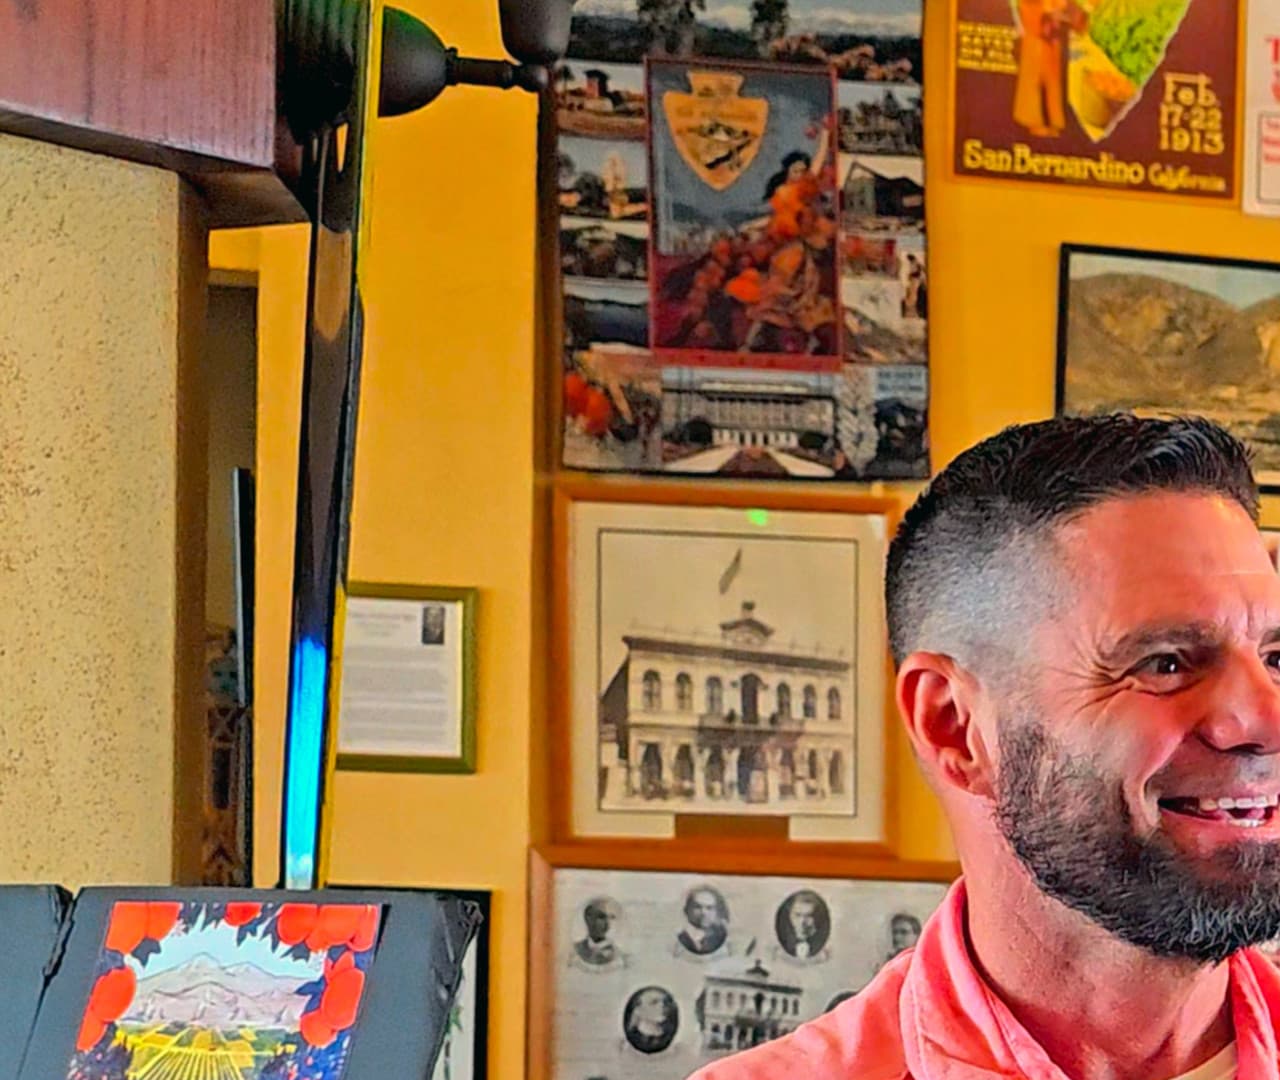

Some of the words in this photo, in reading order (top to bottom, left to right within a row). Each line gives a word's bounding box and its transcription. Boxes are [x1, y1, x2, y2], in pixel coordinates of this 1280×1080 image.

[1160, 128, 1225, 155] 1913
[963, 139, 1012, 173] San
[1013, 143, 1145, 184] Bernardino
